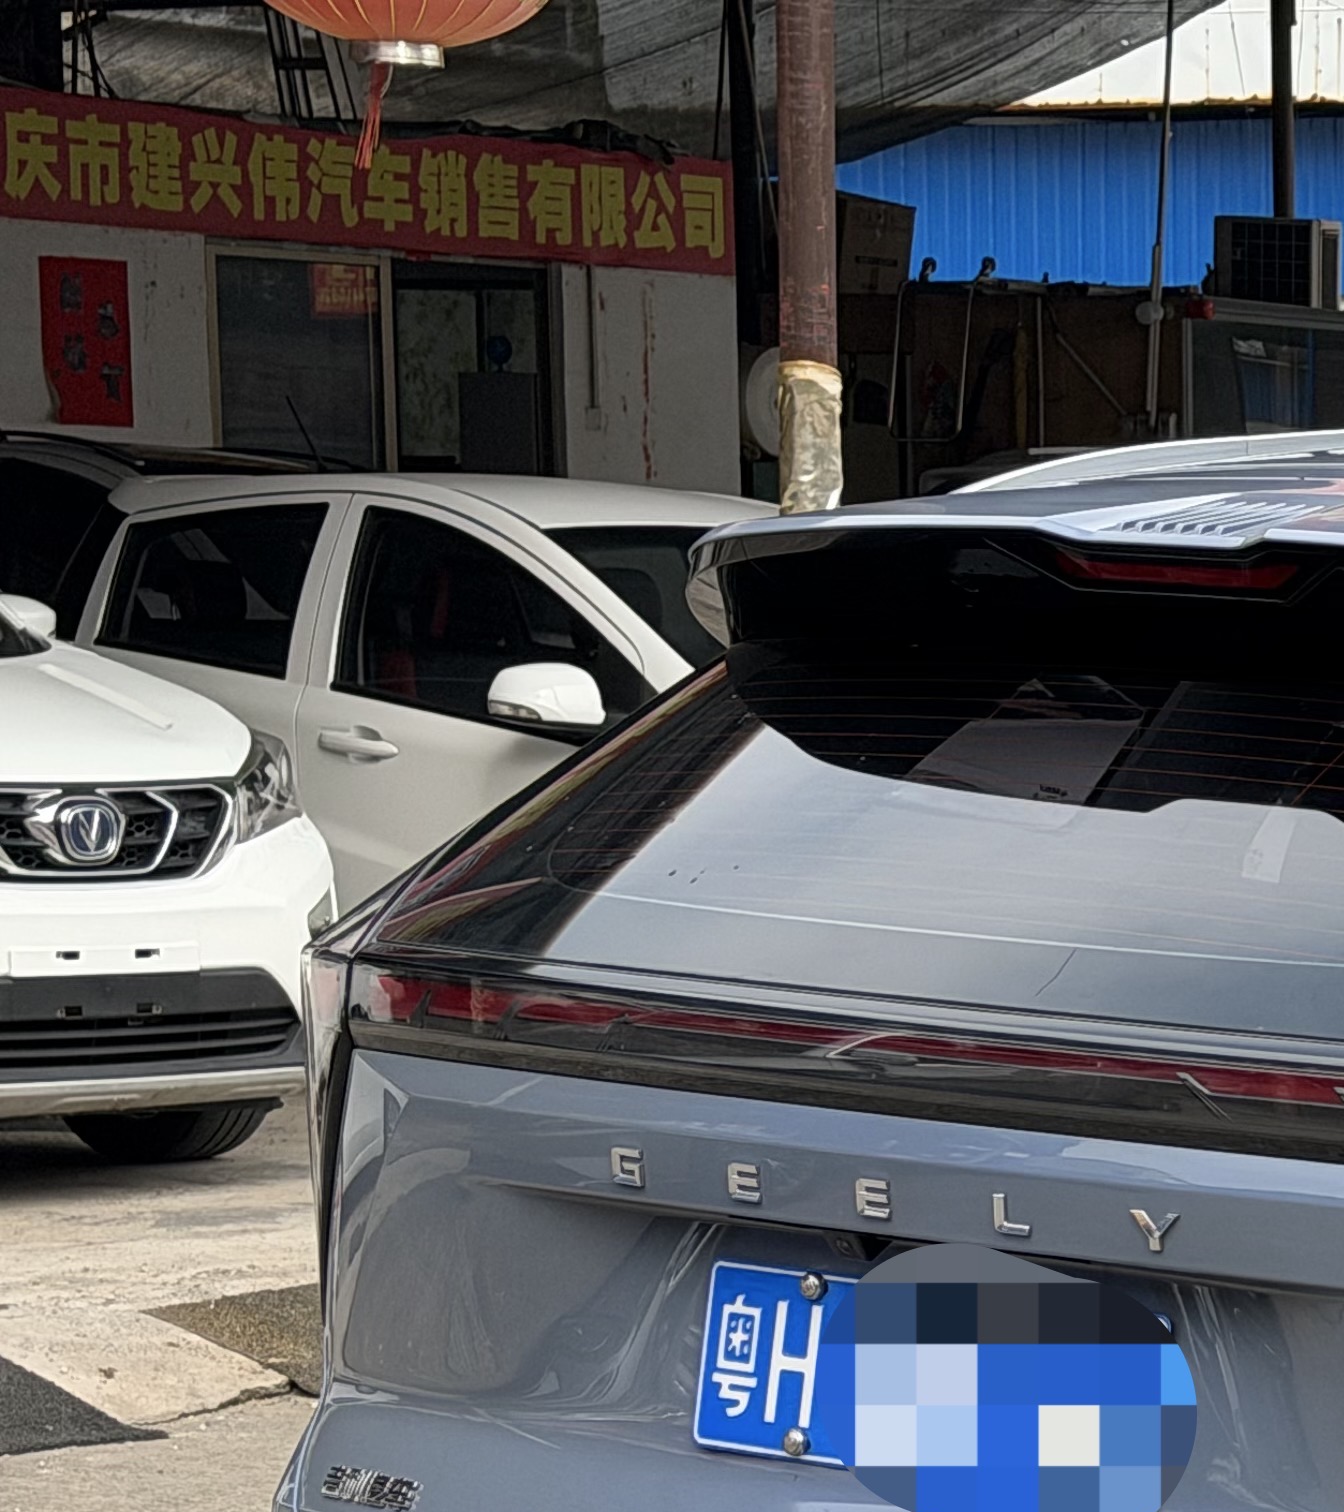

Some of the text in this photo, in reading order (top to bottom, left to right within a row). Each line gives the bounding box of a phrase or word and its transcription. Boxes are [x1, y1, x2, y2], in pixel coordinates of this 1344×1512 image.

[4, 107, 726, 259] 庆市建兴伟汽车销售有限公司
[610, 1146, 1180, 1253] GEELY
